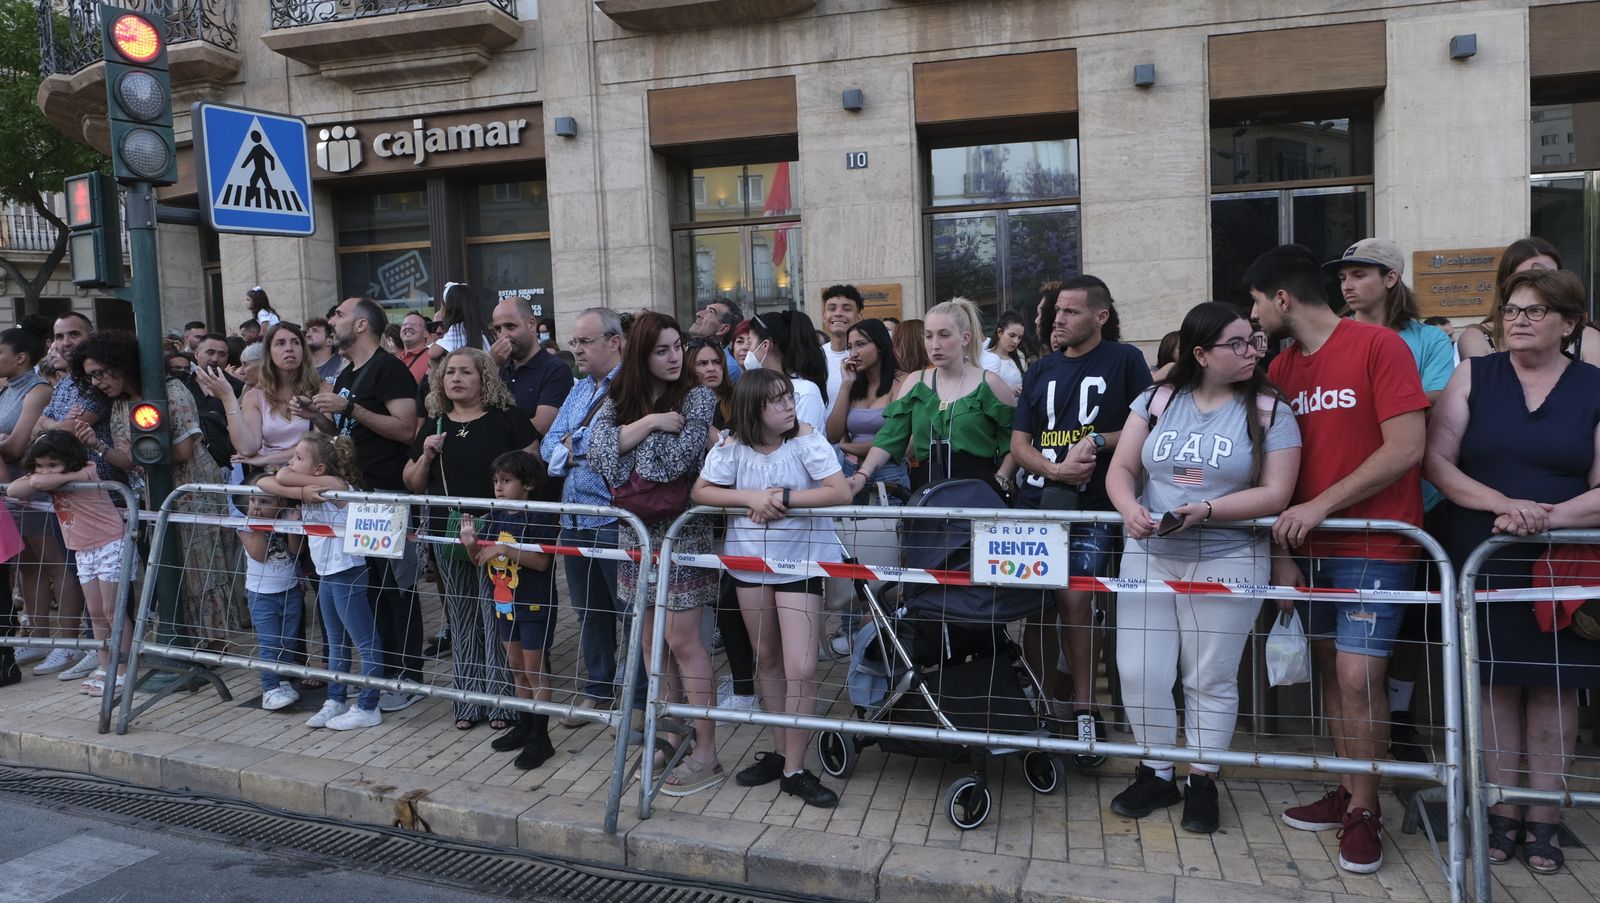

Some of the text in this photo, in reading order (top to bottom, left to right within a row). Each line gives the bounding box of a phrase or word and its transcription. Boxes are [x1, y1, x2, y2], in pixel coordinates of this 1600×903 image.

[373, 118, 527, 166] cajamar
[849, 152, 866, 168] 10
[1431, 281, 1492, 294] centro de
[1291, 386, 1357, 416] didas
[1152, 430, 1233, 469] GAP
[357, 505, 395, 514] GRUPO
[989, 526, 1048, 535] GRUPO
[353, 534, 392, 551] TODO
[988, 541, 1049, 556] RENTA
[988, 560, 1049, 580] TODO
[1206, 576, 1249, 584] CHILL
